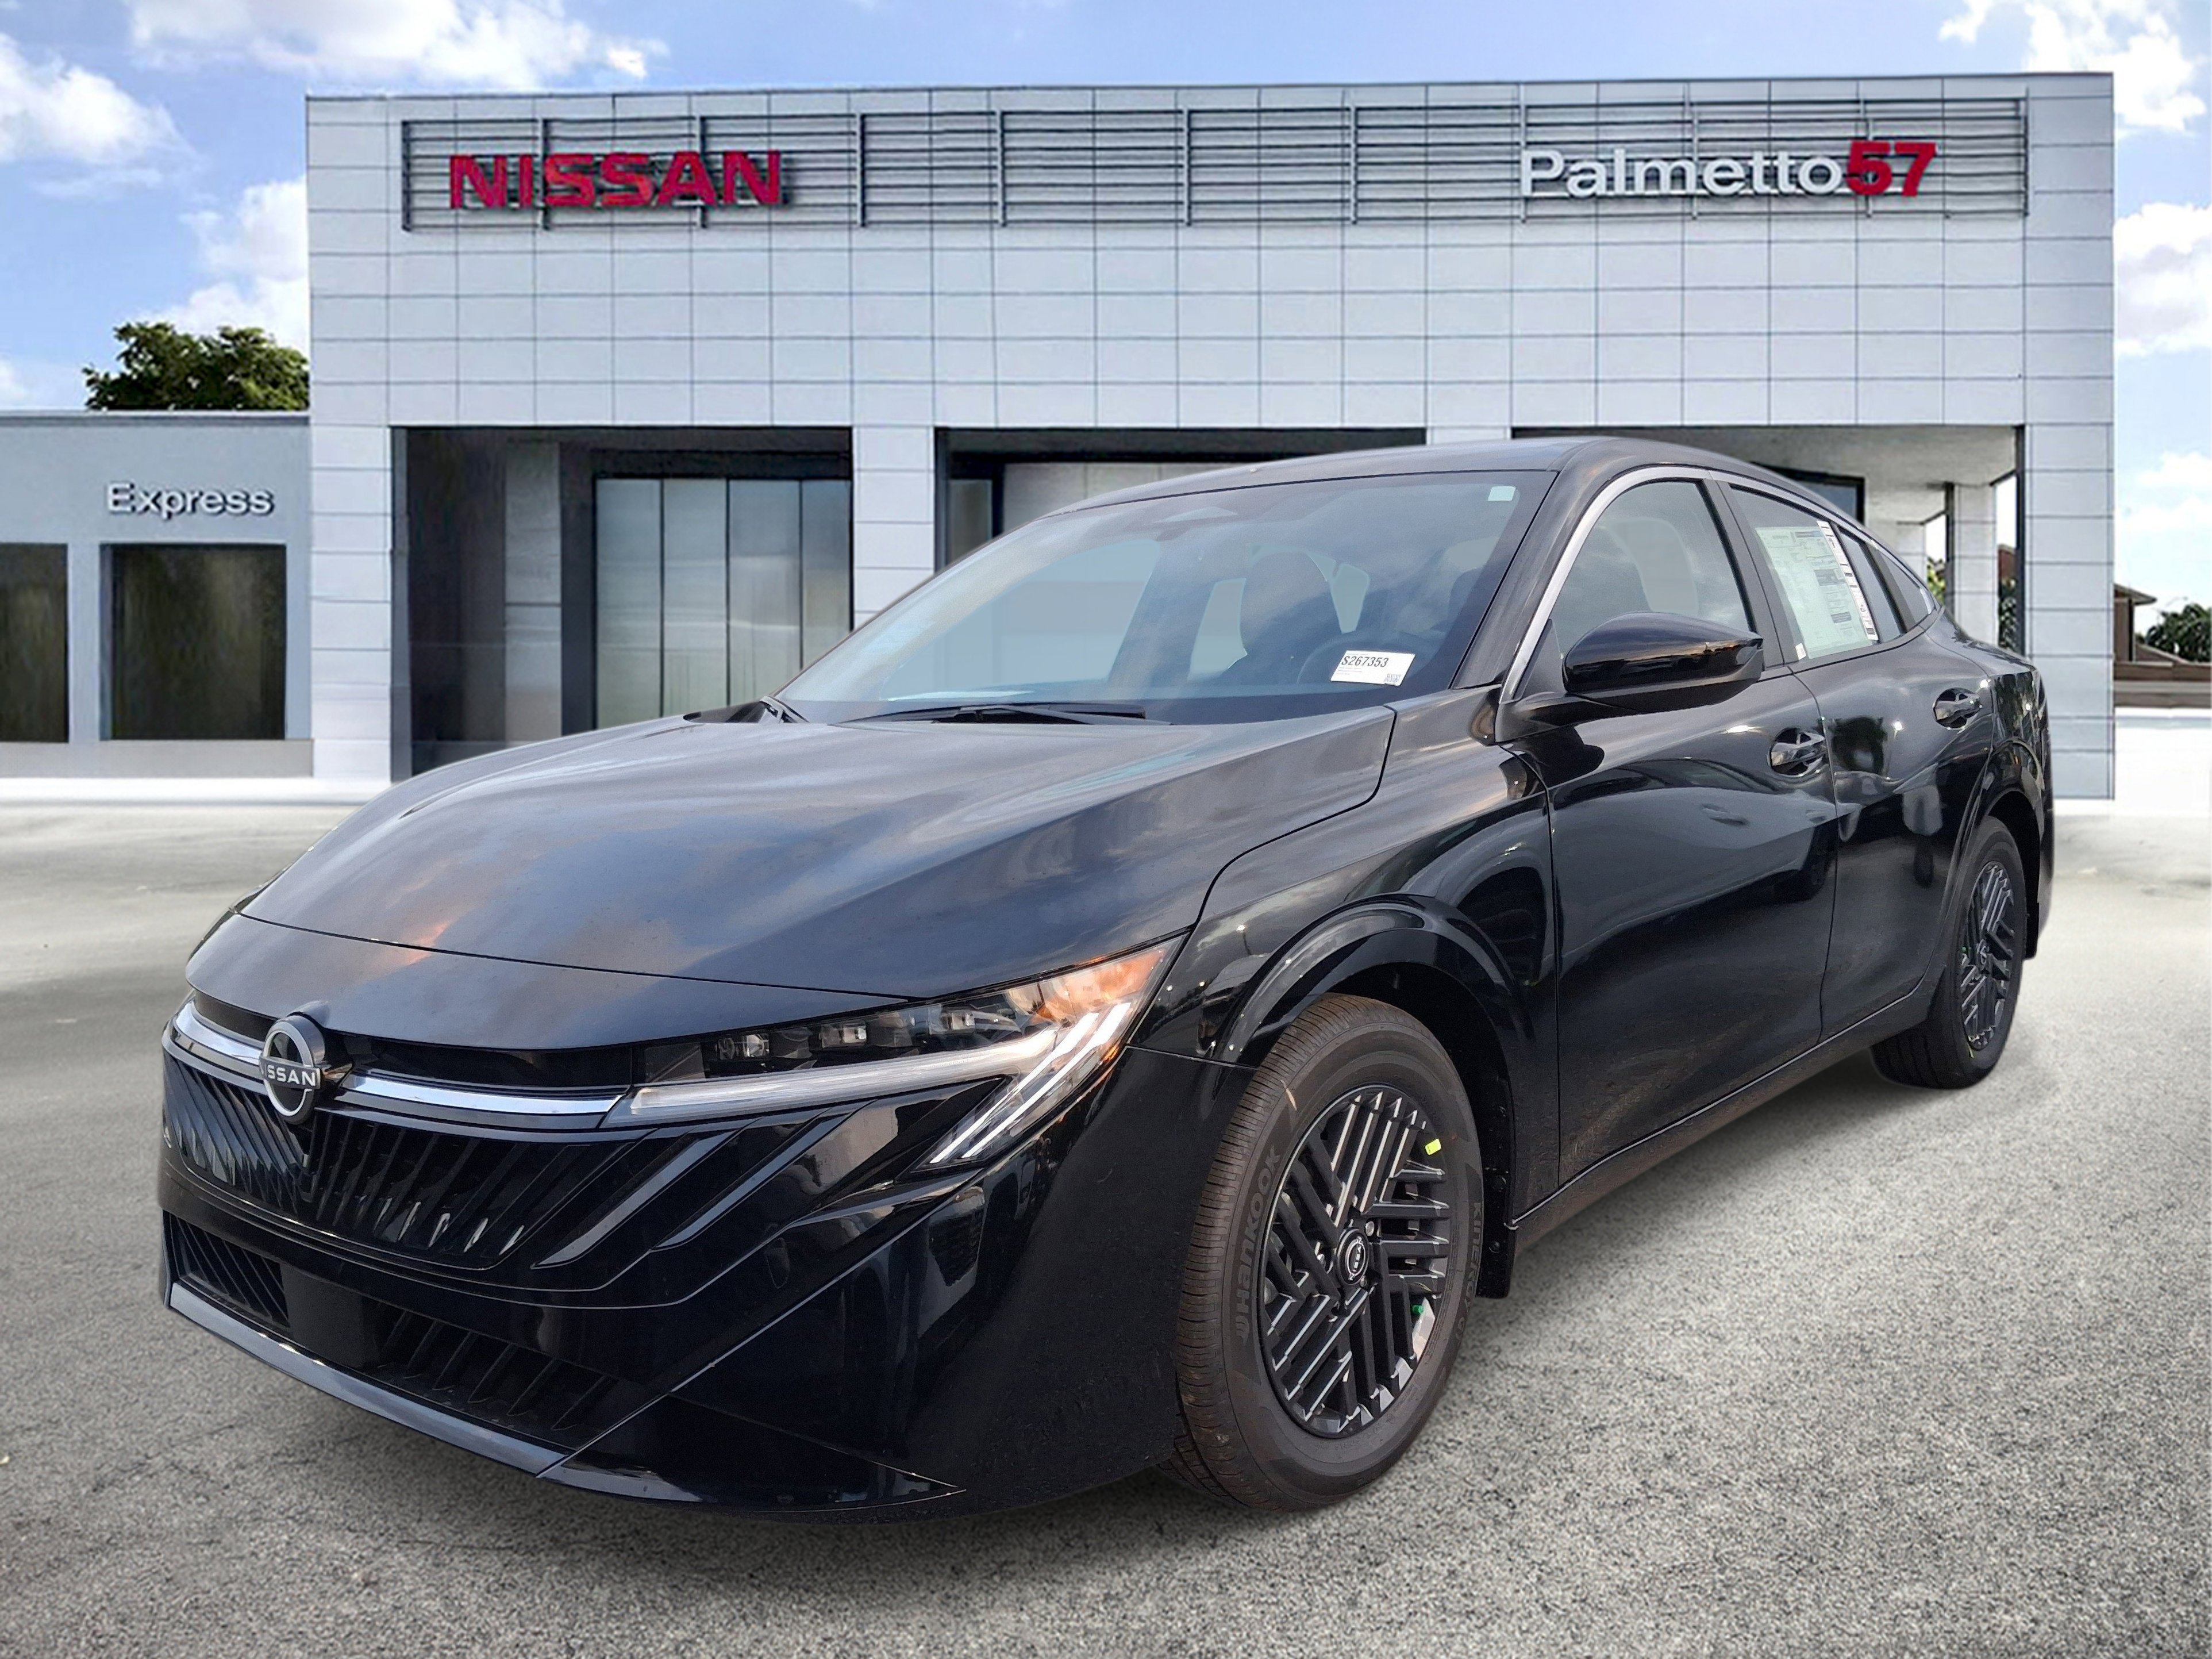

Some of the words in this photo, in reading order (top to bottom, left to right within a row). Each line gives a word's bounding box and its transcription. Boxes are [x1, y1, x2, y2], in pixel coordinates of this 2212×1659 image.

[450, 150, 780, 209] NISSAN
[108, 482, 274, 519] Express
[1341, 655, 1389, 667] S267353
